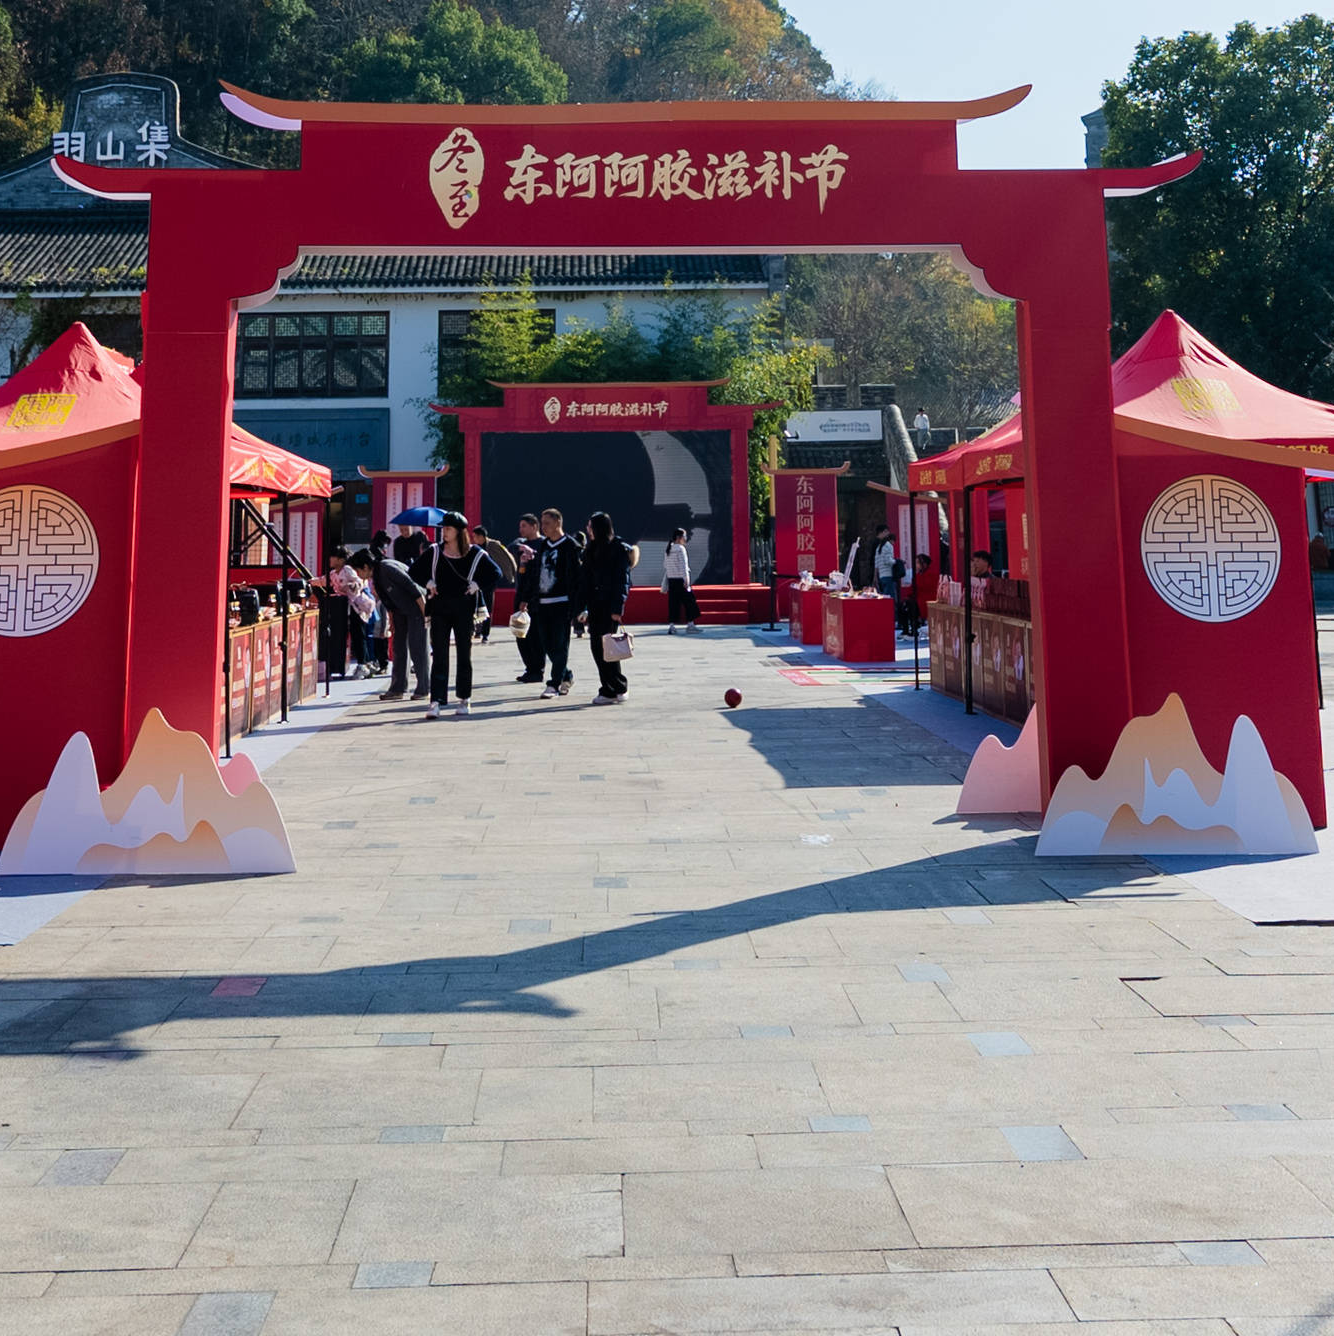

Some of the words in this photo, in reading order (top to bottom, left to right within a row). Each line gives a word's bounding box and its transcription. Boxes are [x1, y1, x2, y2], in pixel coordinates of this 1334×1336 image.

[433, 130, 478, 222] 冬至
[503, 144, 849, 215] 东阿阿胶滋补节
[566, 401, 669, 419] 东阿阿胶滋补节
[796, 476, 816, 552] 东阿阿胶
